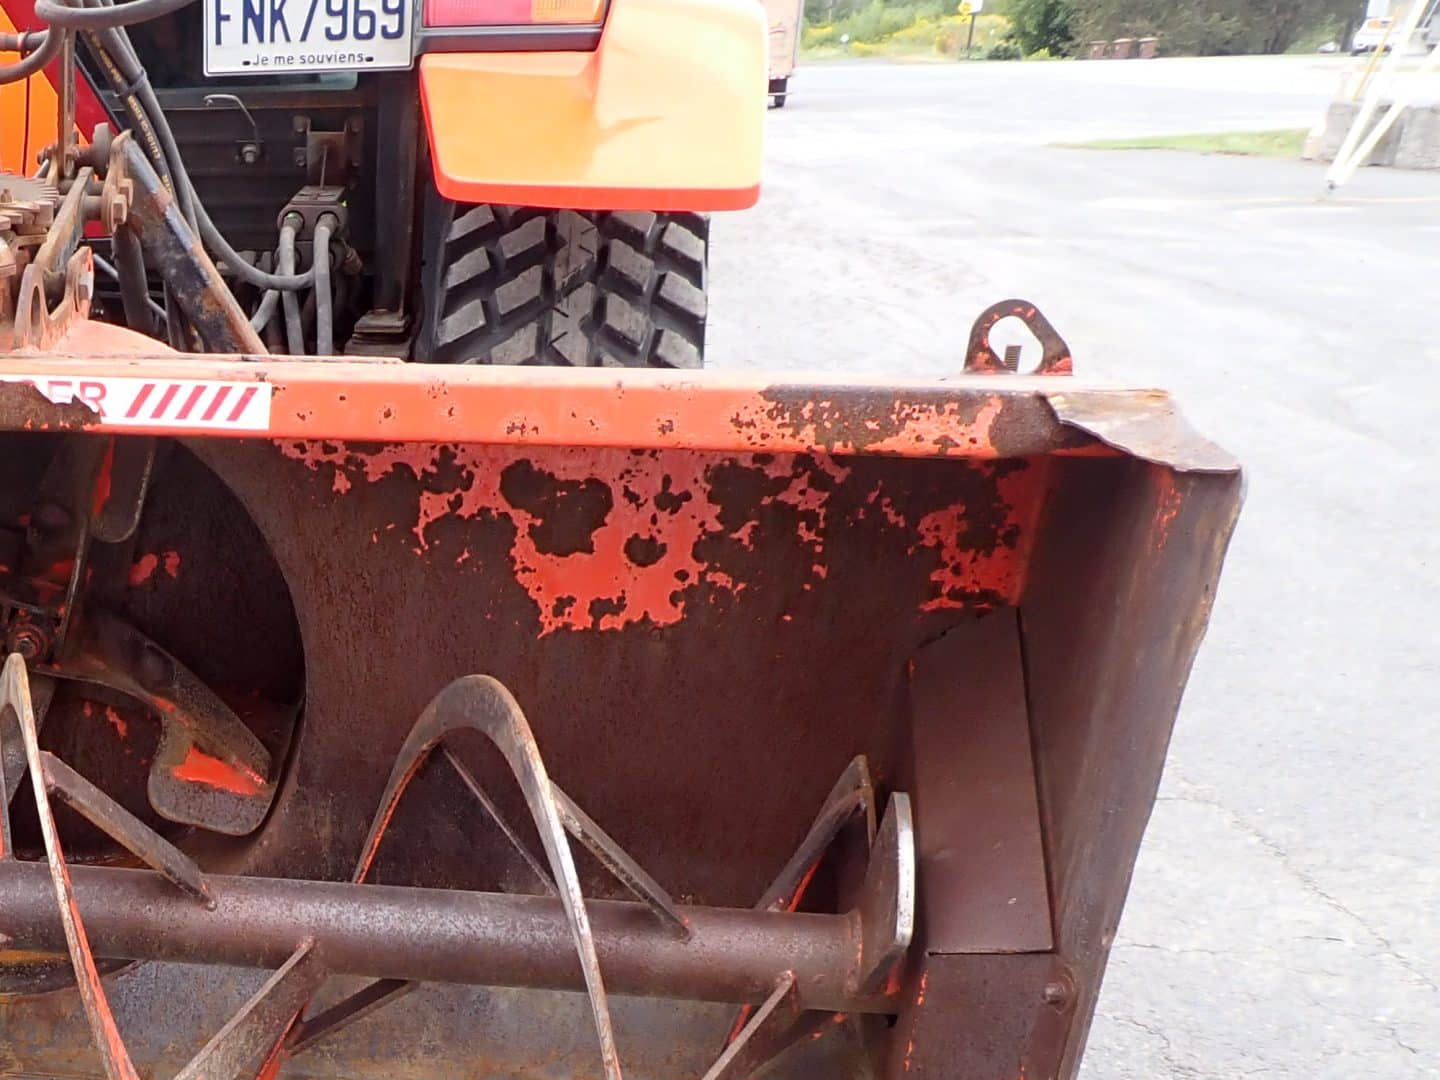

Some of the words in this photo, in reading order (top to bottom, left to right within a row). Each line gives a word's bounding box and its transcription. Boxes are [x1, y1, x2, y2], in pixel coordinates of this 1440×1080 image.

[252, 54, 269, 66] Je
[274, 54, 295, 65] me
[299, 52, 365, 64] souviens
